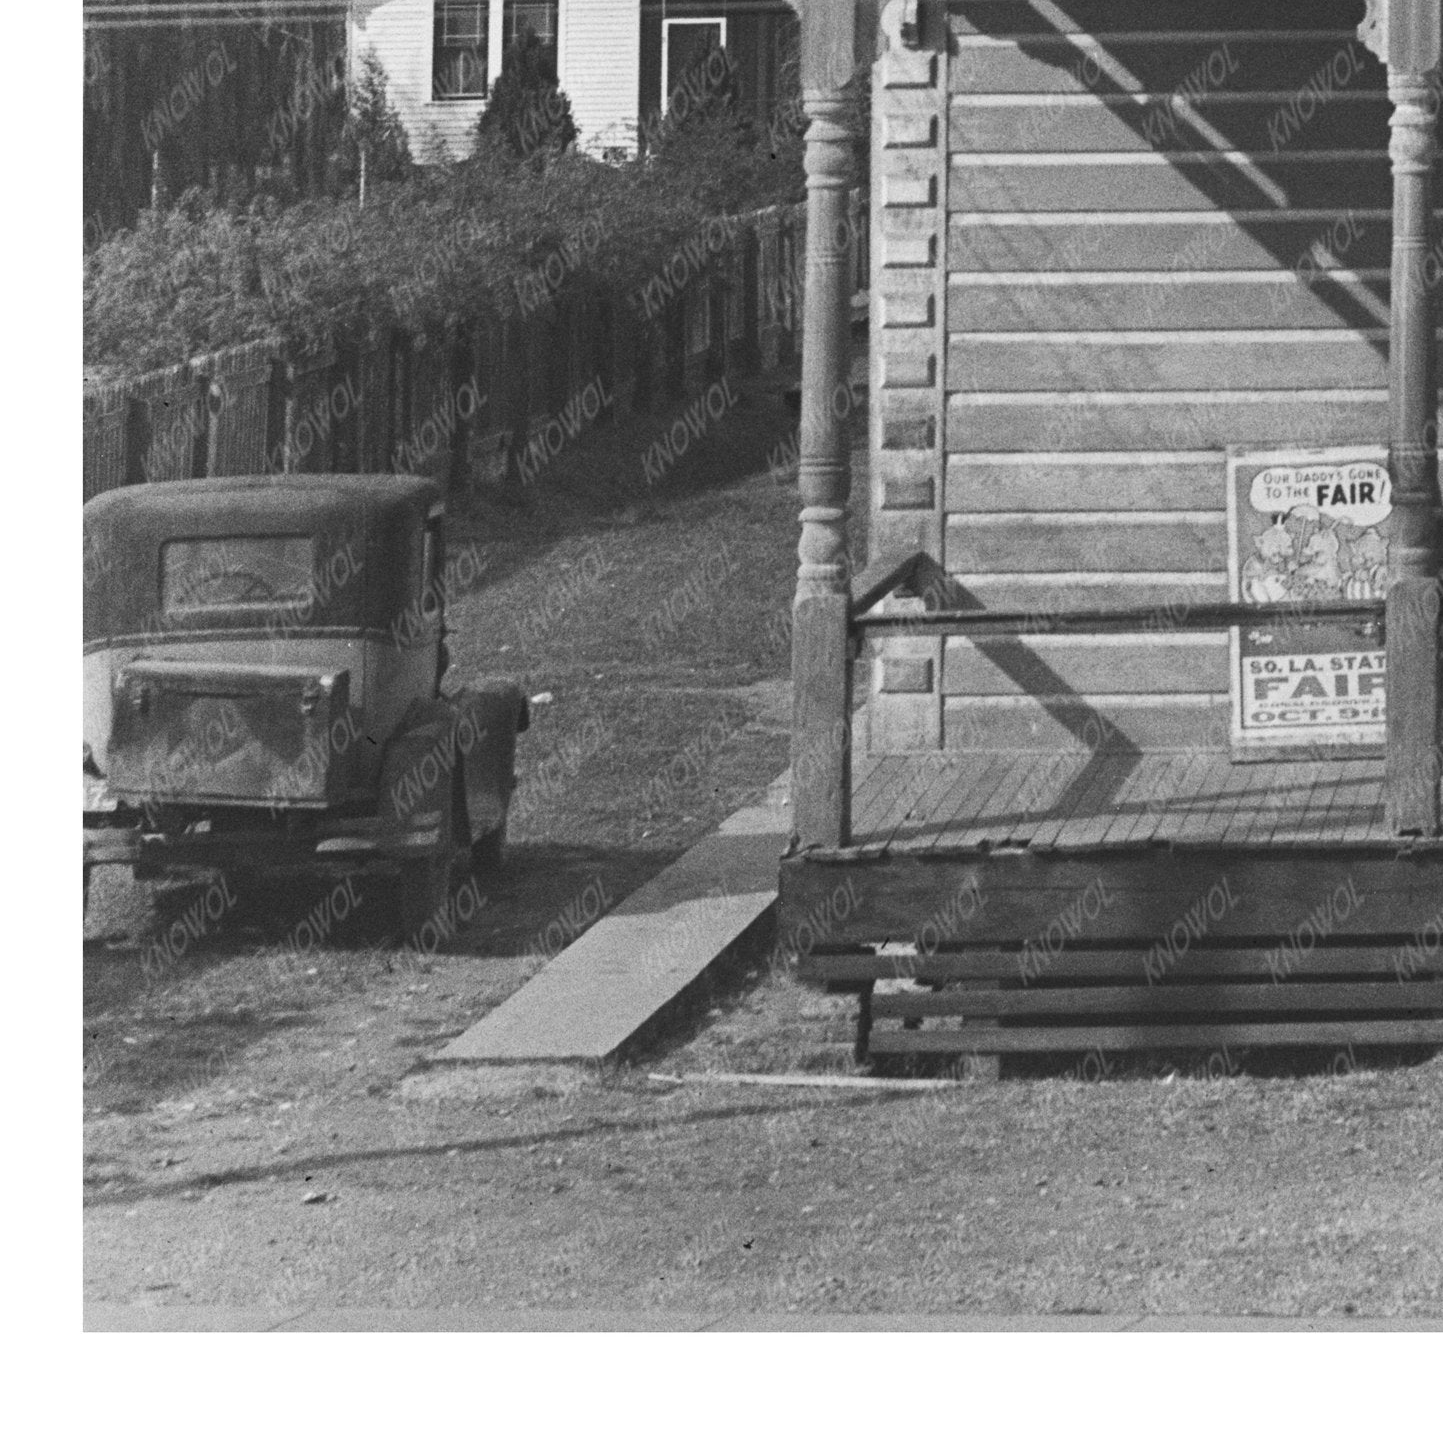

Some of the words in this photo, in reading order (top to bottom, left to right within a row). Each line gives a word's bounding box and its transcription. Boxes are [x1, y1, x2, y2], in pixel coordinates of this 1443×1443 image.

[1263, 472, 1289, 484] OUR
[1295, 468, 1343, 483] DADDY'S
[1265, 486, 1282, 499] TO
[1286, 485, 1310, 498] THE
[1317, 480, 1386, 506] FAIR!
[1250, 660, 1283, 674] SO.
[1289, 657, 1324, 673] LA.
[1329, 654, 1386, 671] STAT
[1250, 707, 1332, 723] OCT.
